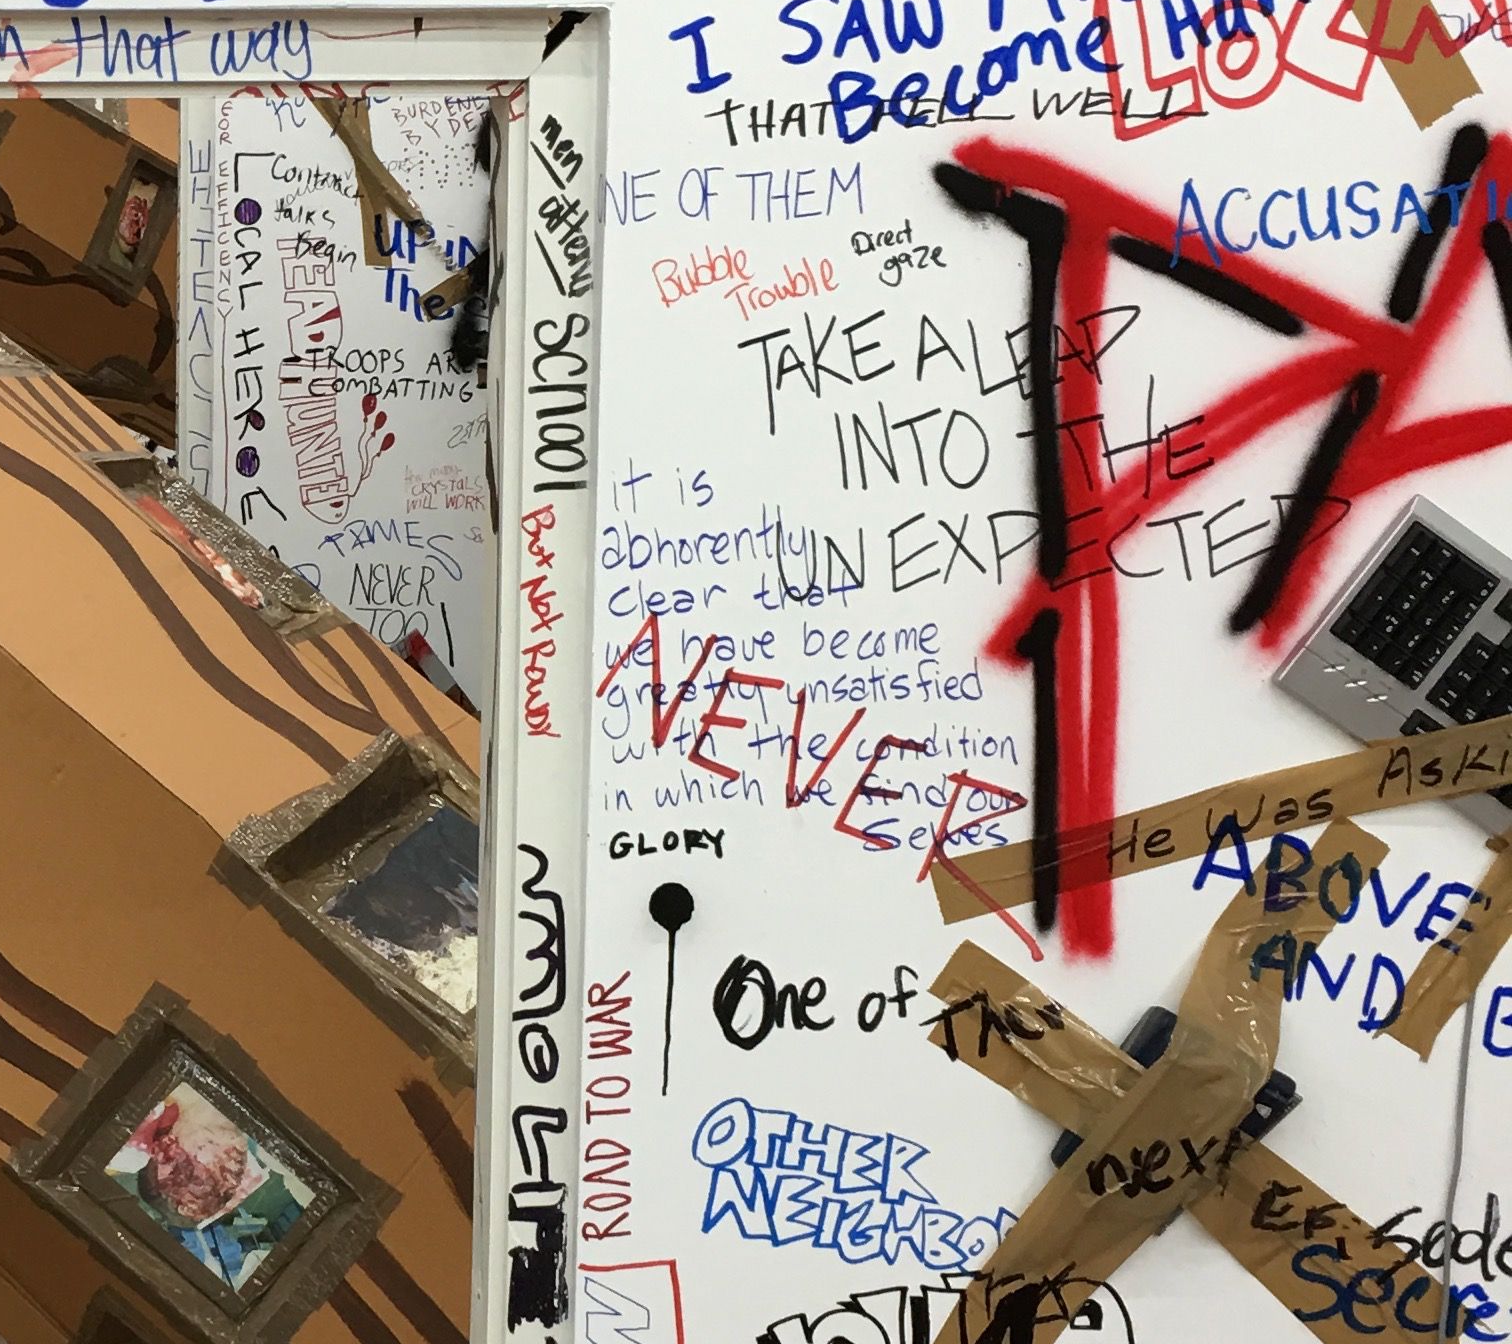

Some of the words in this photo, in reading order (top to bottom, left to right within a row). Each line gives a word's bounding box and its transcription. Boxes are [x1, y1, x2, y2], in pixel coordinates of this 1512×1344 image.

[208, 16, 315, 83] way
[667, 14, 733, 96] I
[736, 161, 864, 223] THEM
[850, 218, 916, 257] Direct
[651, 244, 755, 309] Bubble
[722, 256, 842, 323] Trouble
[304, 346, 406, 376] TROOPS
[737, 308, 895, 436] TAKE
[914, 312, 967, 384] A
[834, 399, 989, 492] INTO
[610, 456, 654, 515] it
[675, 465, 715, 508] is
[348, 561, 435, 608] NEVER
[608, 578, 728, 618] clear
[753, 566, 865, 612] that
[680, 628, 777, 664] have
[802, 619, 943, 659] become
[746, 720, 829, 761] the
[603, 781, 631, 813] in
[654, 771, 765, 812] which
[608, 826, 726, 861] GLORY
[583, 968, 634, 1060] WAR
[856, 963, 920, 1034] of
[584, 1072, 634, 1125] TO
[691, 1095, 940, 1205] OTHER
[580, 1136, 634, 1242] ROAD
